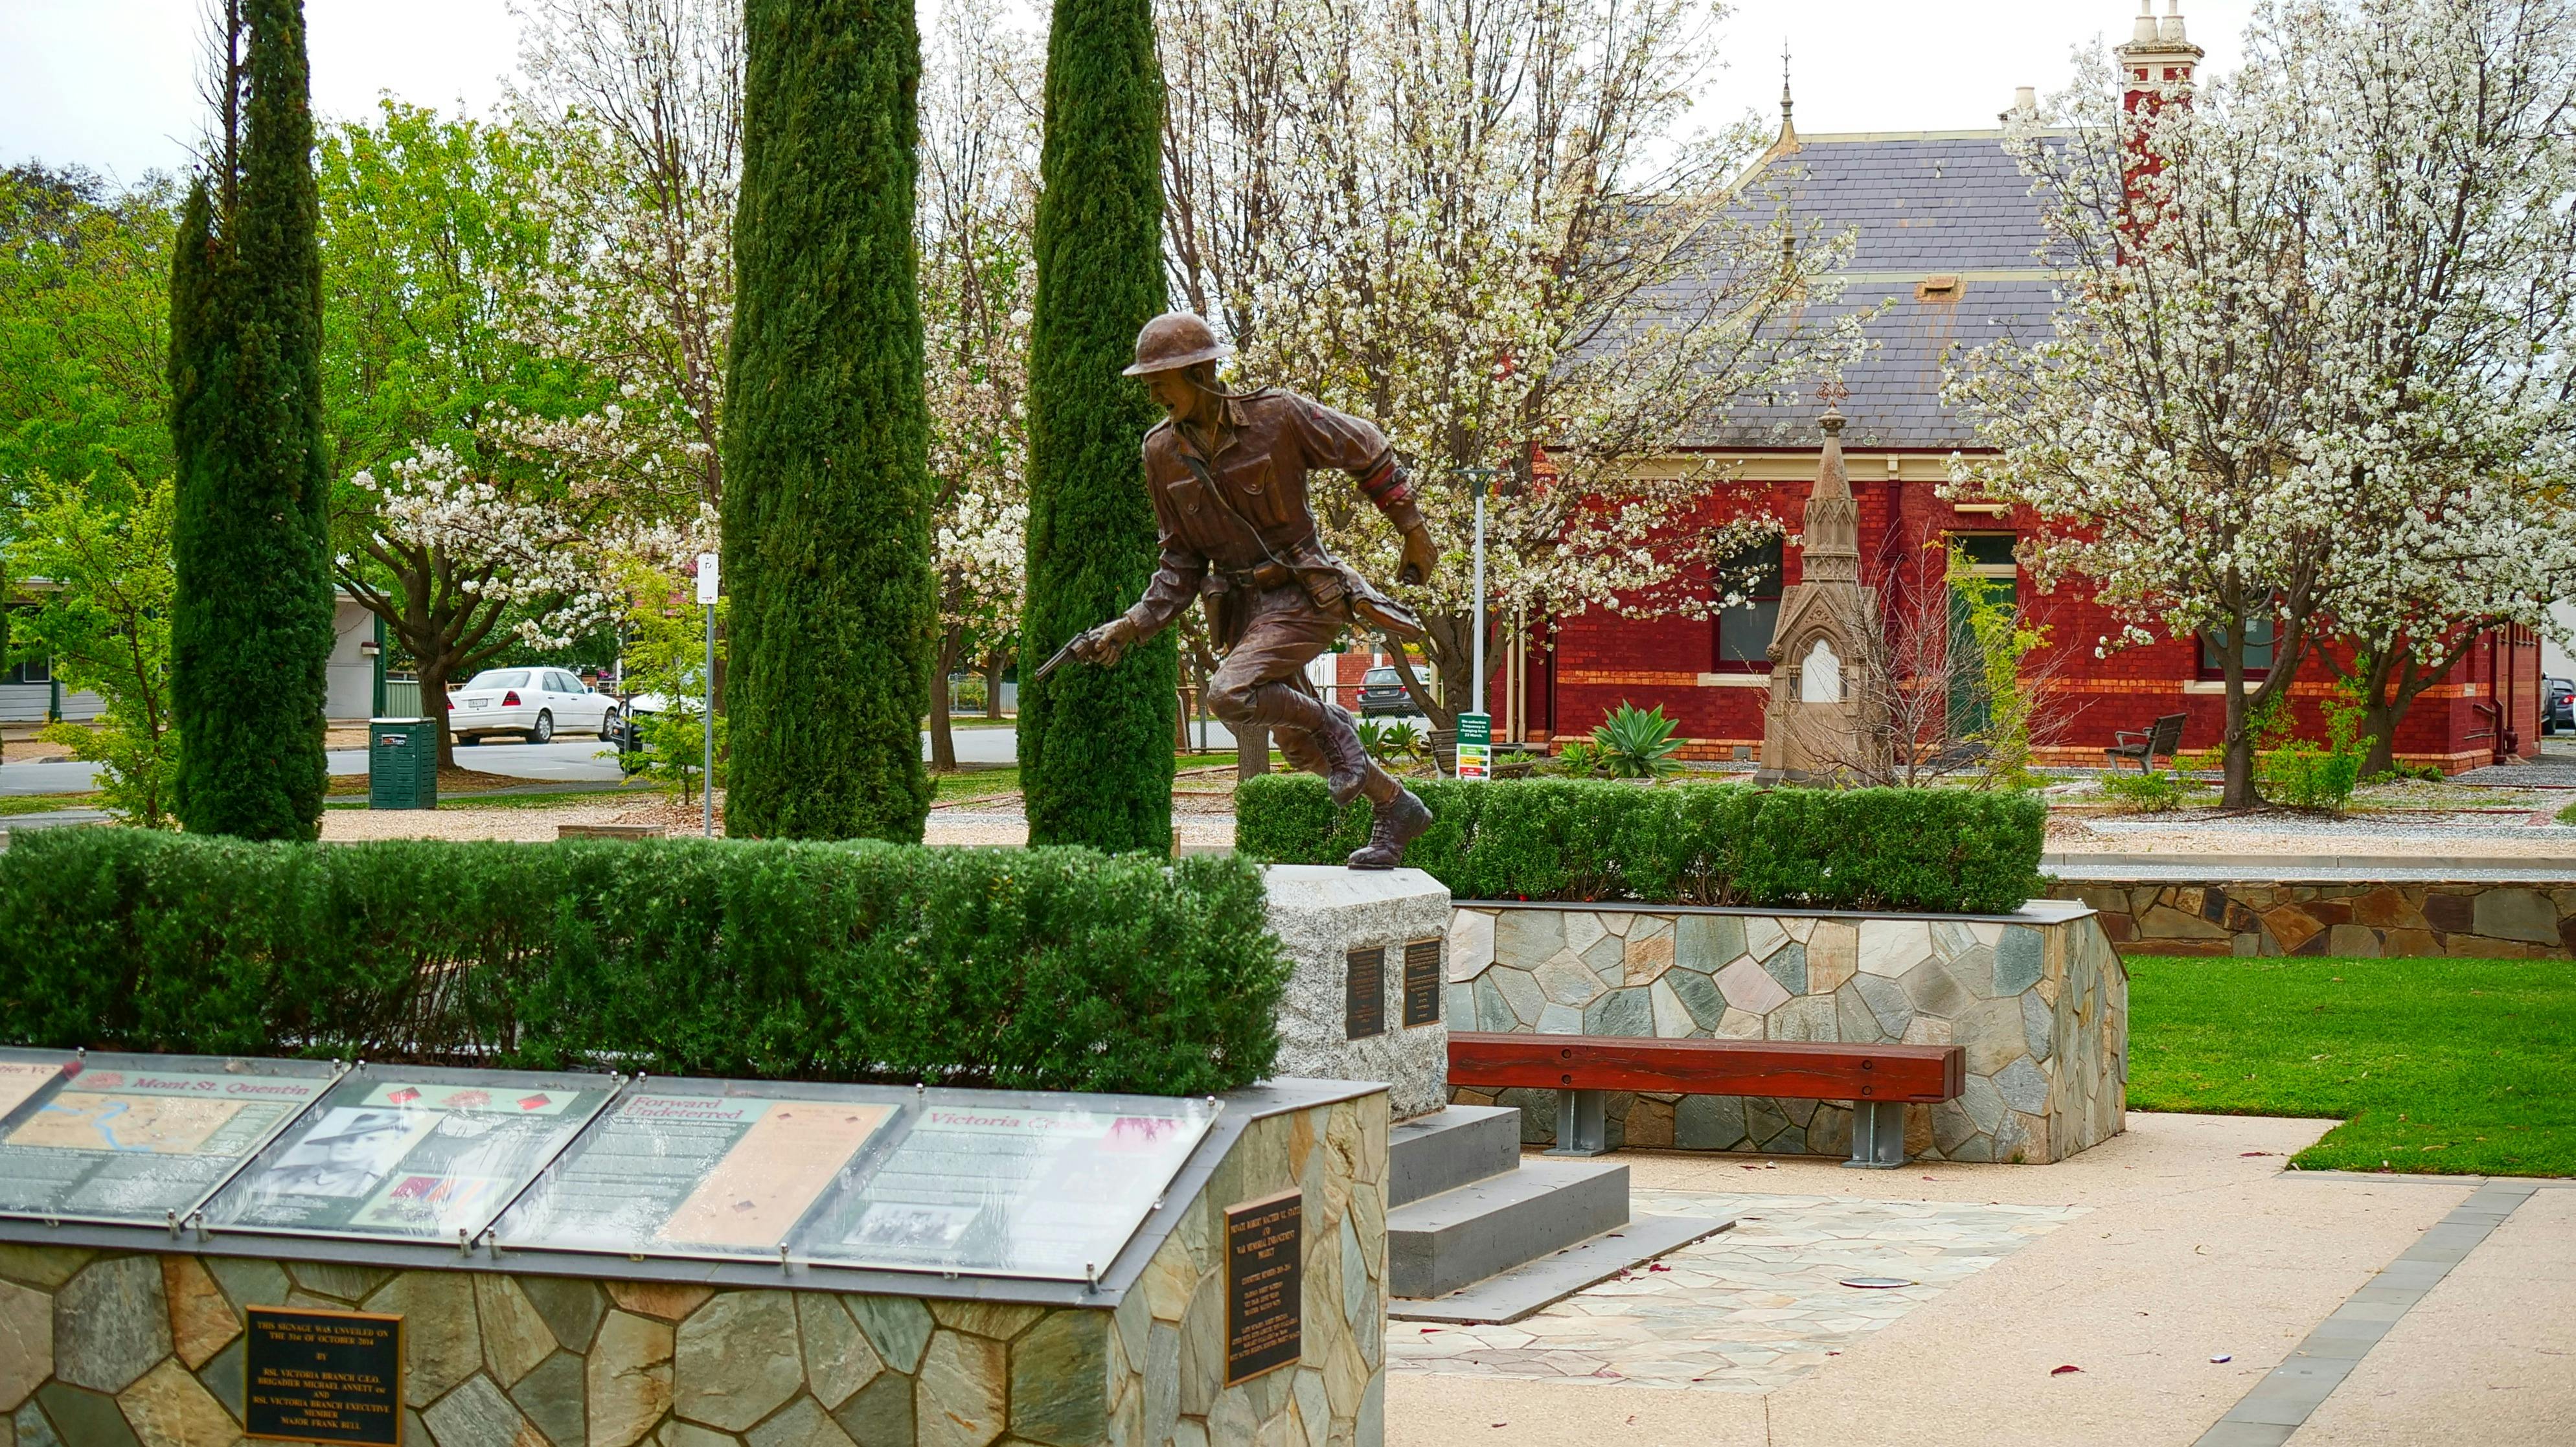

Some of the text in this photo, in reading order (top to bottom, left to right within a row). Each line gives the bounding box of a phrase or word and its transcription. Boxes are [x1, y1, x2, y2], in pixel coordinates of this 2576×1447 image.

[131, 1077, 310, 1096] Mont St. Quentin
[632, 1097, 723, 1109] Forward
[624, 1106, 744, 1119] Undeterred
[931, 1113, 1020, 1128] Victoria
[279, 1323, 312, 1332] SIGNAGE
[315, 1325, 332, 1334] WAS
[334, 1327, 374, 1337] UNVEILED
[269, 1331, 285, 1340] THE
[304, 1334, 315, 1343] OF
[318, 1336, 355, 1345] OCTOBER
[316, 1352, 326, 1361] BY
[263, 1368, 279, 1376] RSL
[280, 1369, 319, 1380] VICTORIA
[321, 1372, 355, 1382] BRANCH
[257, 1377, 301, 1387] BRIGADIER
[302, 1380, 339, 1391] MICHAEL
[342, 1384, 373, 1393] ANNETT
[313, 1391, 330, 1399] AND
[253, 1396, 390, 1413] RSL VICTORIA BRANCH EXECUTIVE
[303, 1409, 338, 1419] MEMBER
[280, 1416, 361, 1431] MAJOR FRANK BELL
